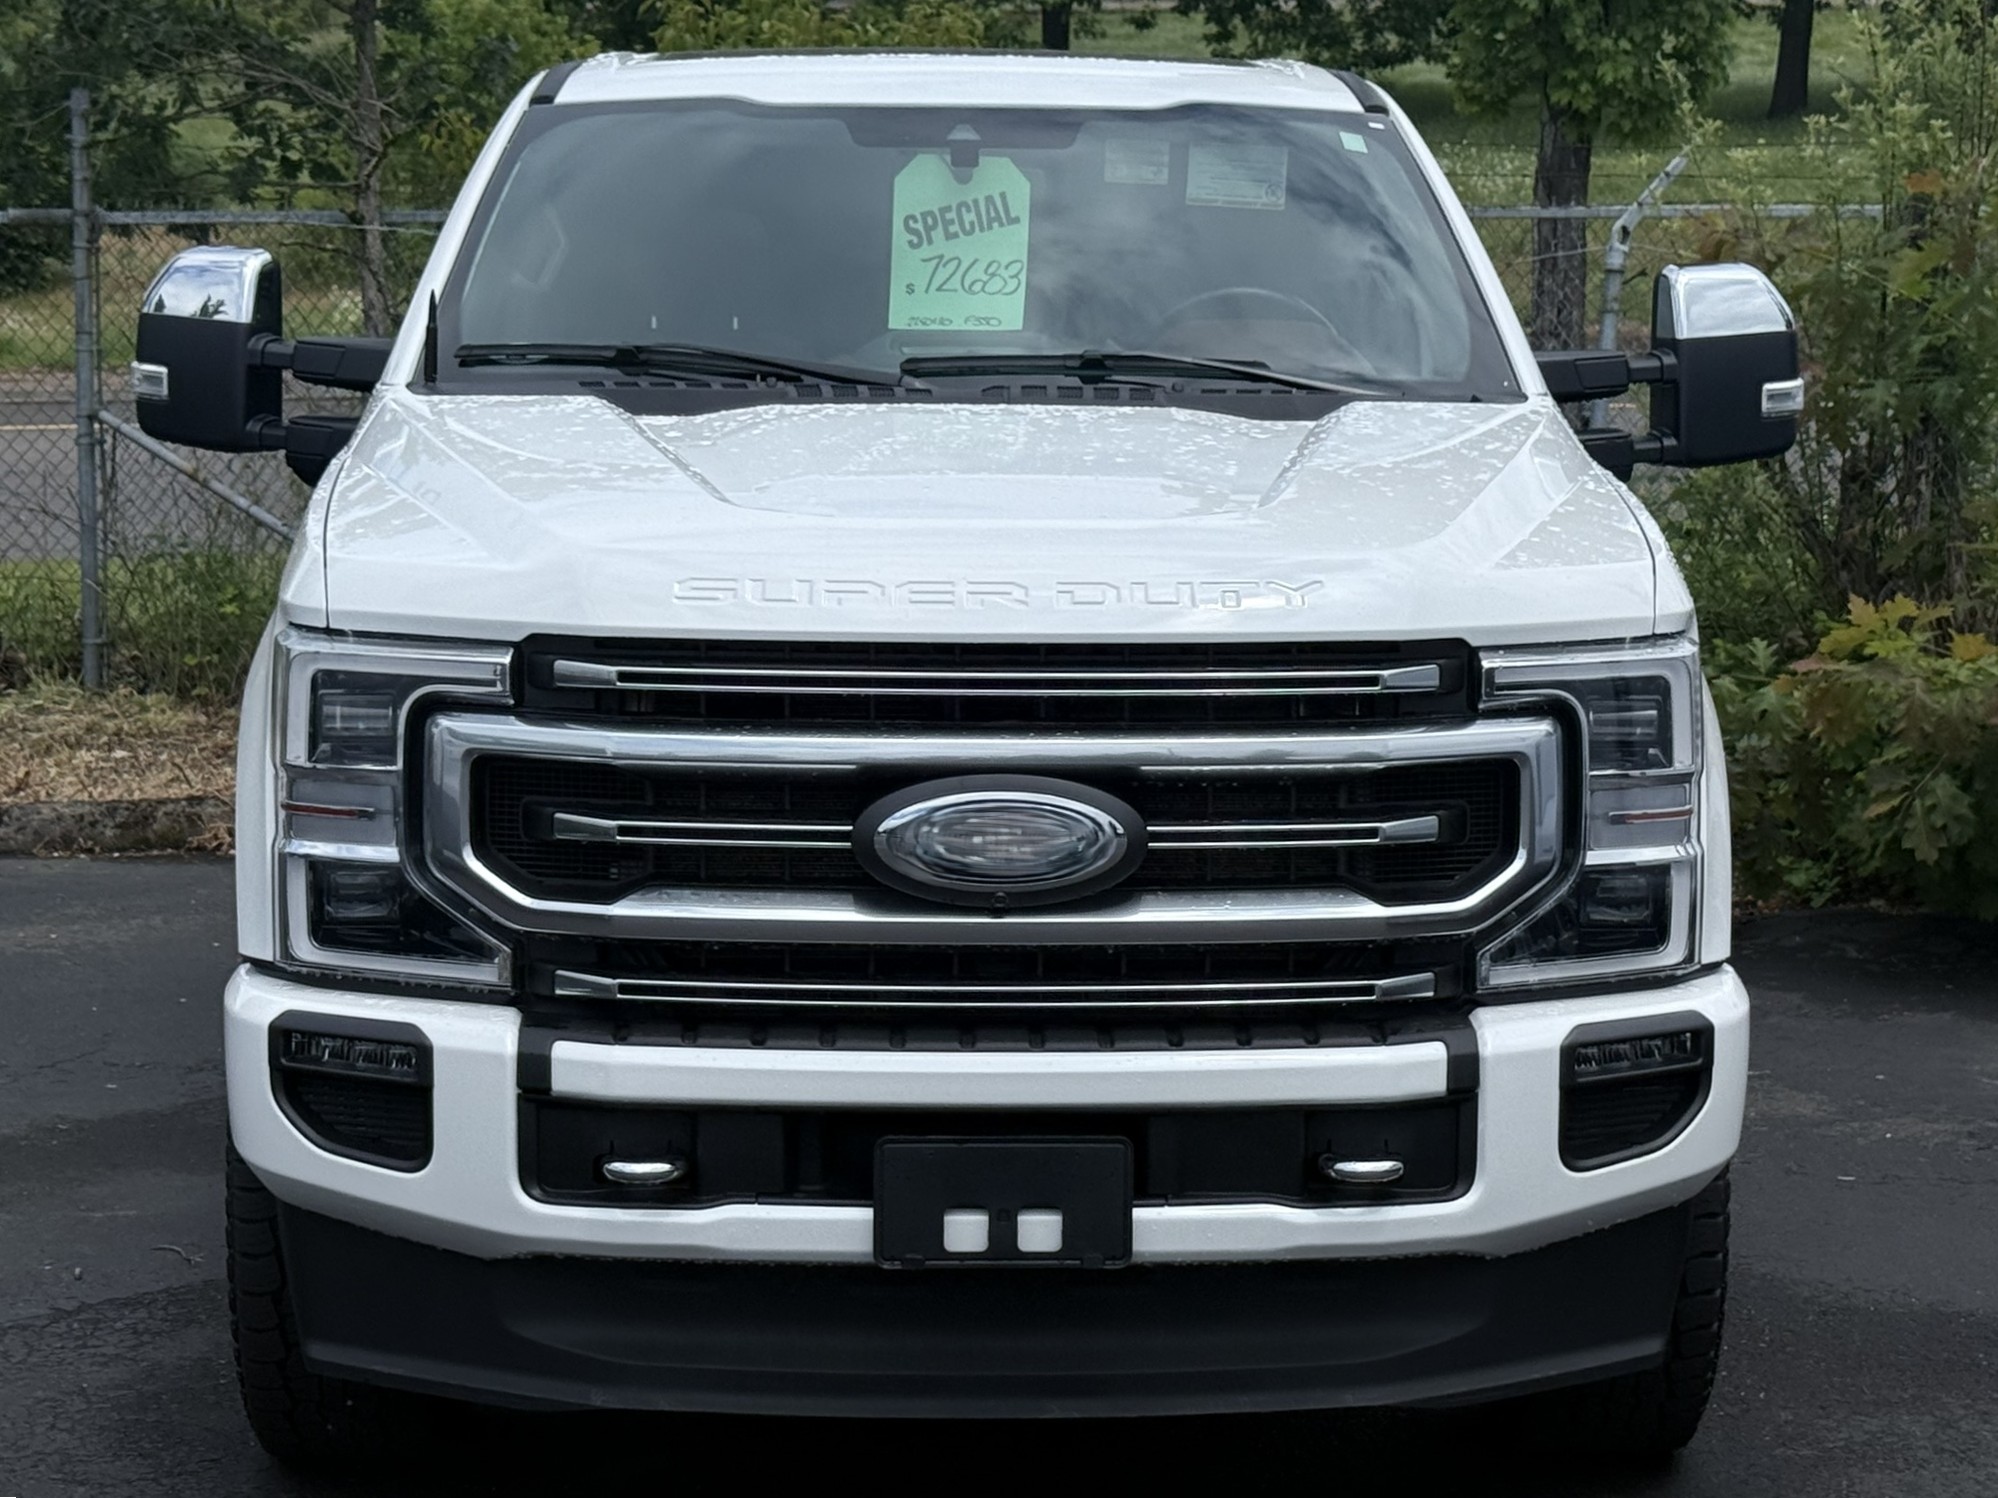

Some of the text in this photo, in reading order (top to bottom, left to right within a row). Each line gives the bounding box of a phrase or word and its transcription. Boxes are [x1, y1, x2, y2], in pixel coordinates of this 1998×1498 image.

[903, 191, 1021, 250] SPECIAL
[672, 577, 1324, 609] SUPER DUTY
